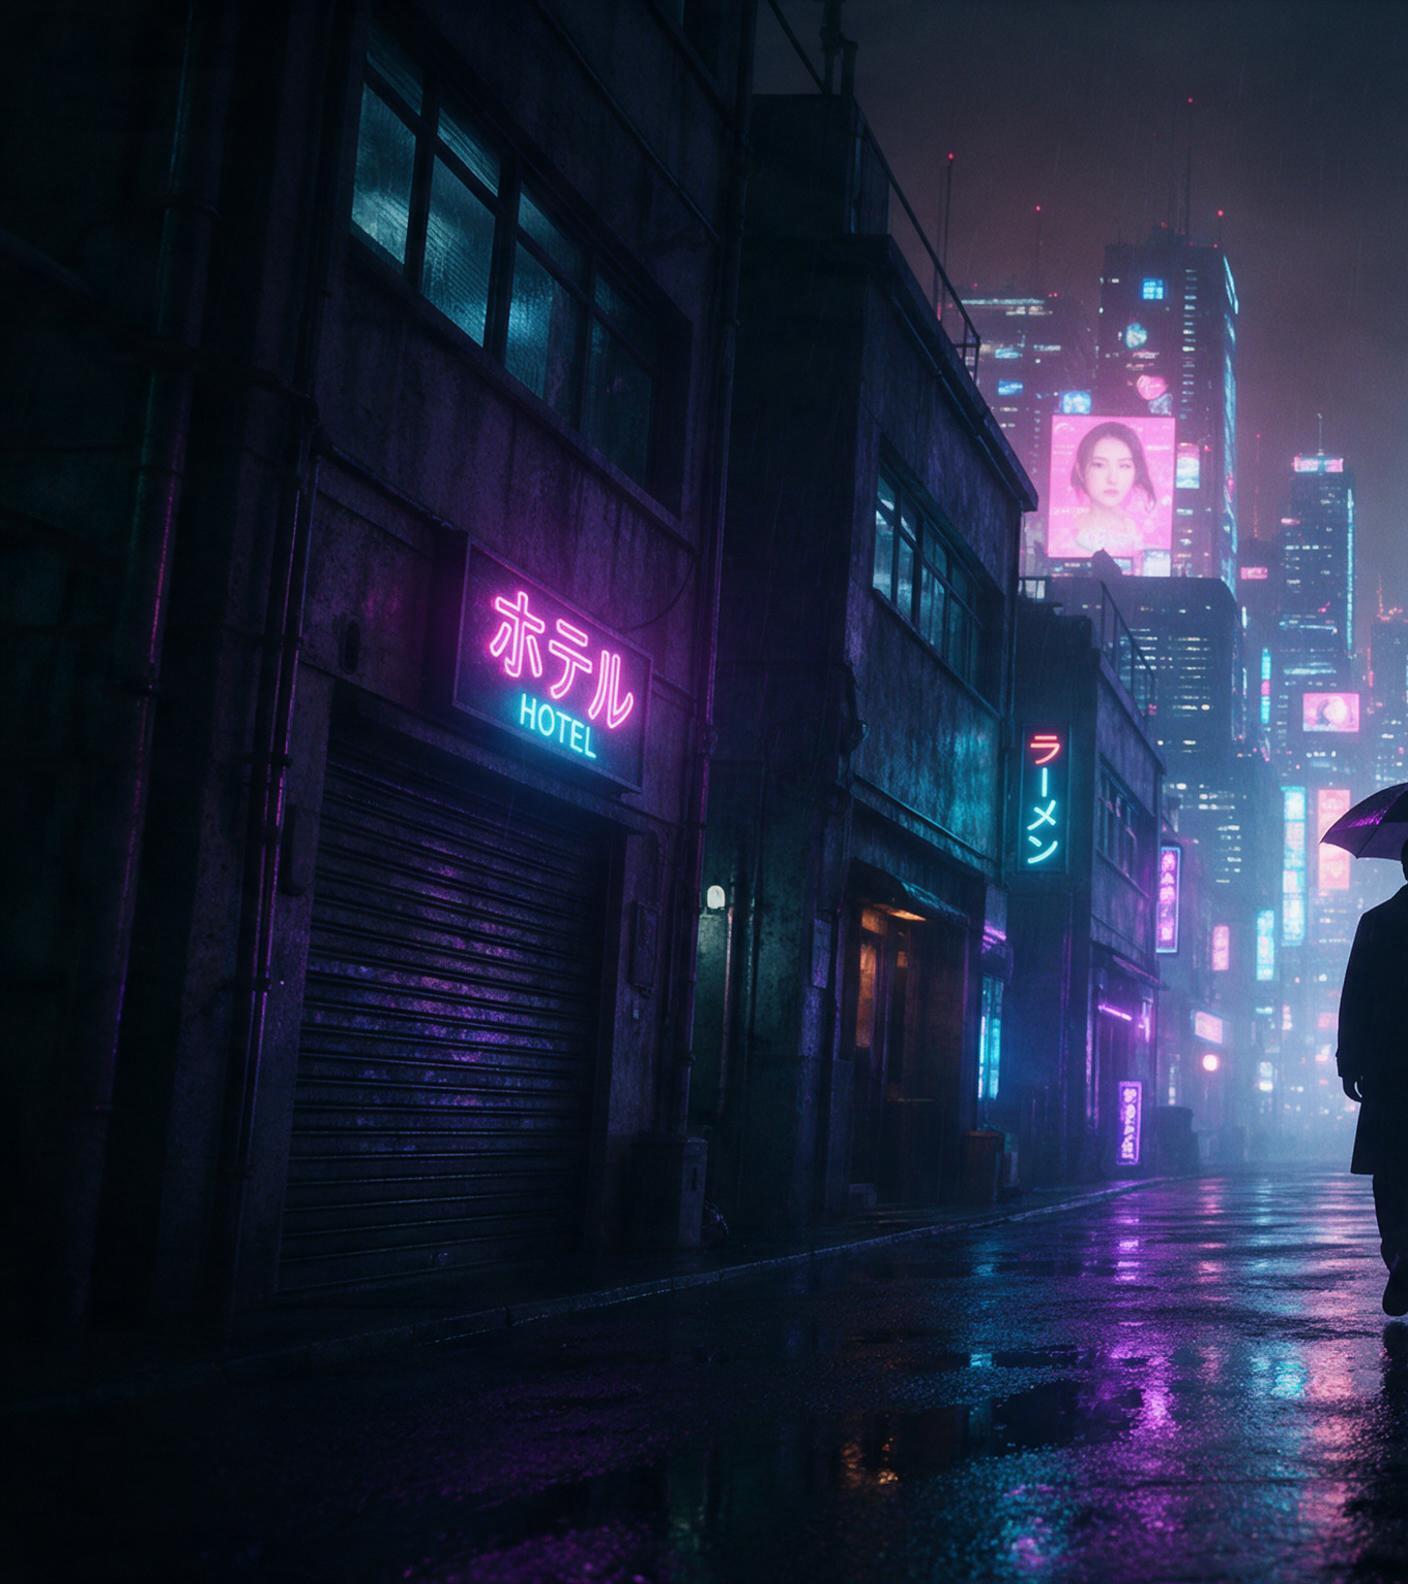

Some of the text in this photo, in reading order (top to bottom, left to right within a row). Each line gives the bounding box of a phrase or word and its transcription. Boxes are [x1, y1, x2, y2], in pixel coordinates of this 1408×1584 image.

[490, 591, 634, 729] ホテル
[519, 693, 597, 758] HOTEL
[1027, 735, 1060, 864] ラーメン
